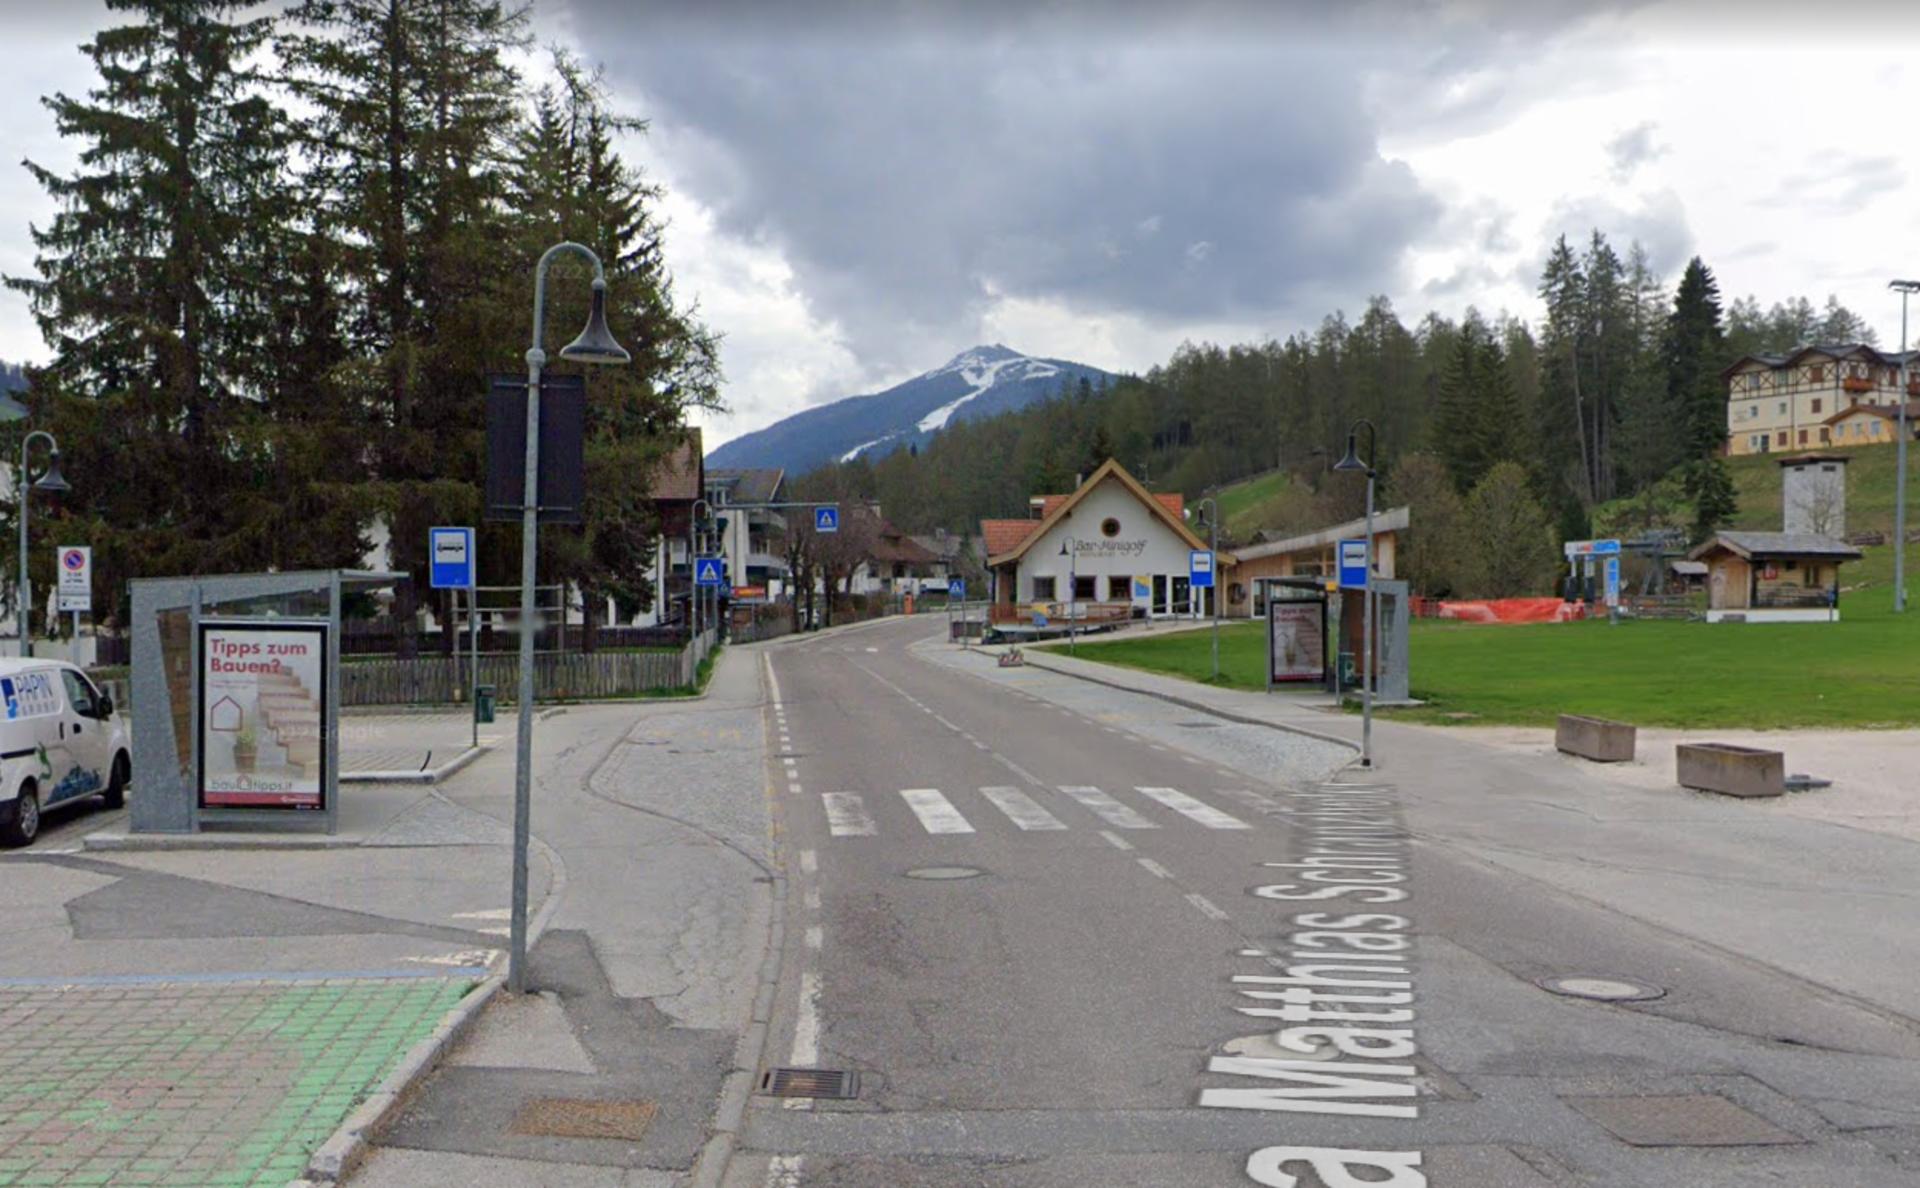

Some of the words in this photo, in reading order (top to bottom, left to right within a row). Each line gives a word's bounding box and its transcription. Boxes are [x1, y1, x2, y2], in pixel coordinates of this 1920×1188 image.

[211, 638, 261, 657] Tipps
[267, 643, 308, 655] zum
[211, 657, 281, 673] Bauen?
